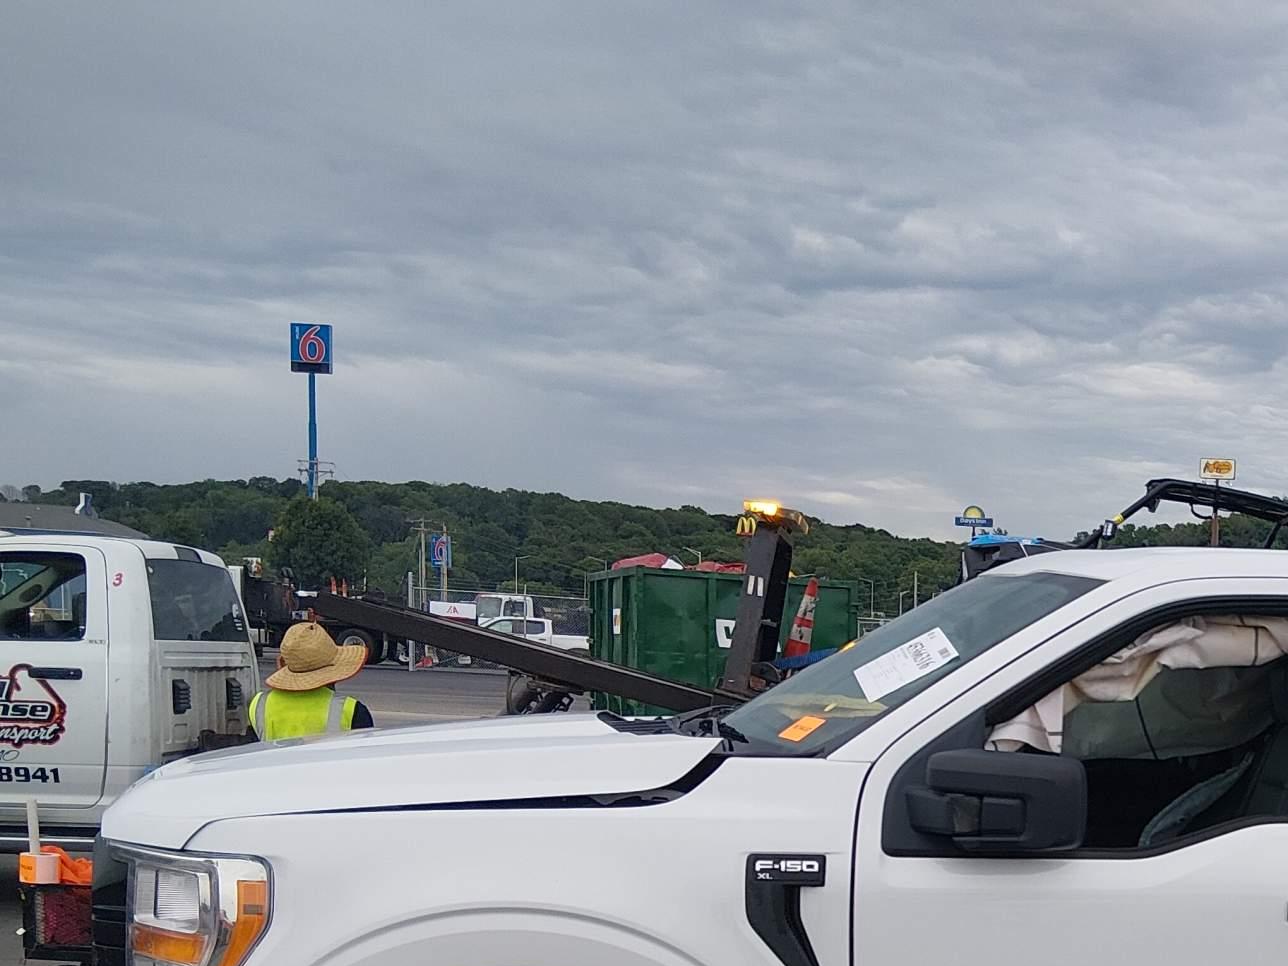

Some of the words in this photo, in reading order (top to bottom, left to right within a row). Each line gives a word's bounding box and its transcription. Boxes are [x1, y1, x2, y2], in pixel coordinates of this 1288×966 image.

[298, 325, 326, 363] 6
[112, 572, 123, 587] 3
[0, 766, 60, 783] 8941
[754, 860, 819, 872] F-150
[757, 872, 774, 880] XL
